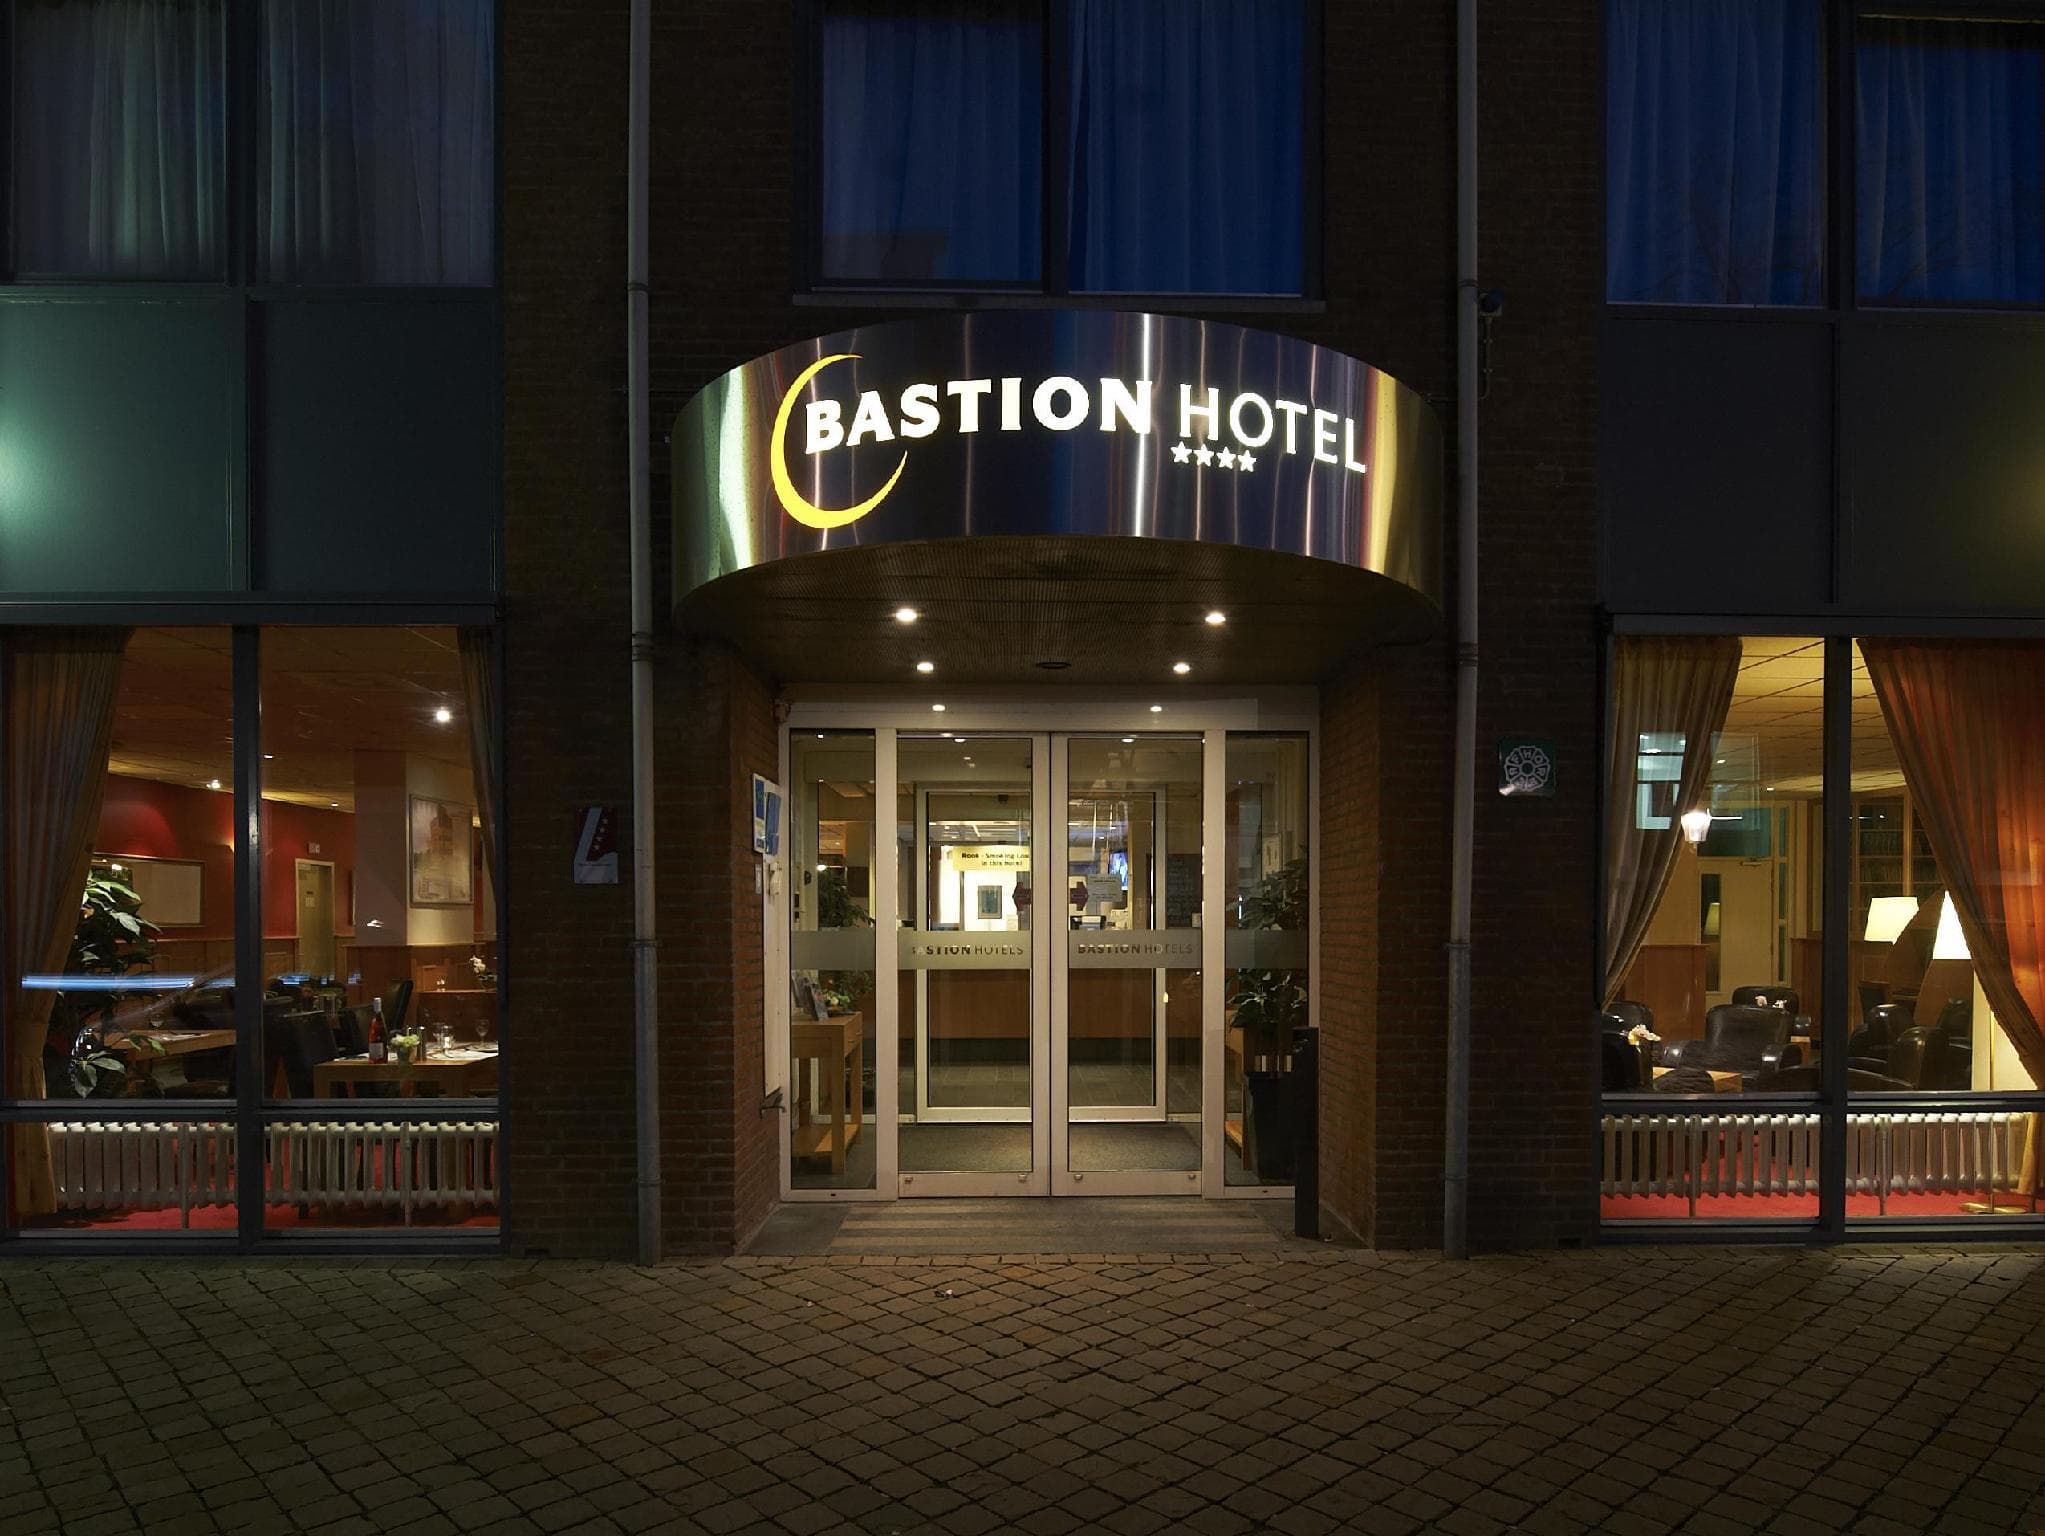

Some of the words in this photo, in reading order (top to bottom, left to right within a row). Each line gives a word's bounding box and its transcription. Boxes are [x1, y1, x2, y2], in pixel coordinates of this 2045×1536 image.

[805, 376, 1153, 456] BASTION
[1179, 383, 1367, 474] HOTEL
[974, 945, 1024, 955] HOTELS
[1077, 944, 1141, 954] BASTION
[1144, 943, 1193, 954] HOTELS
